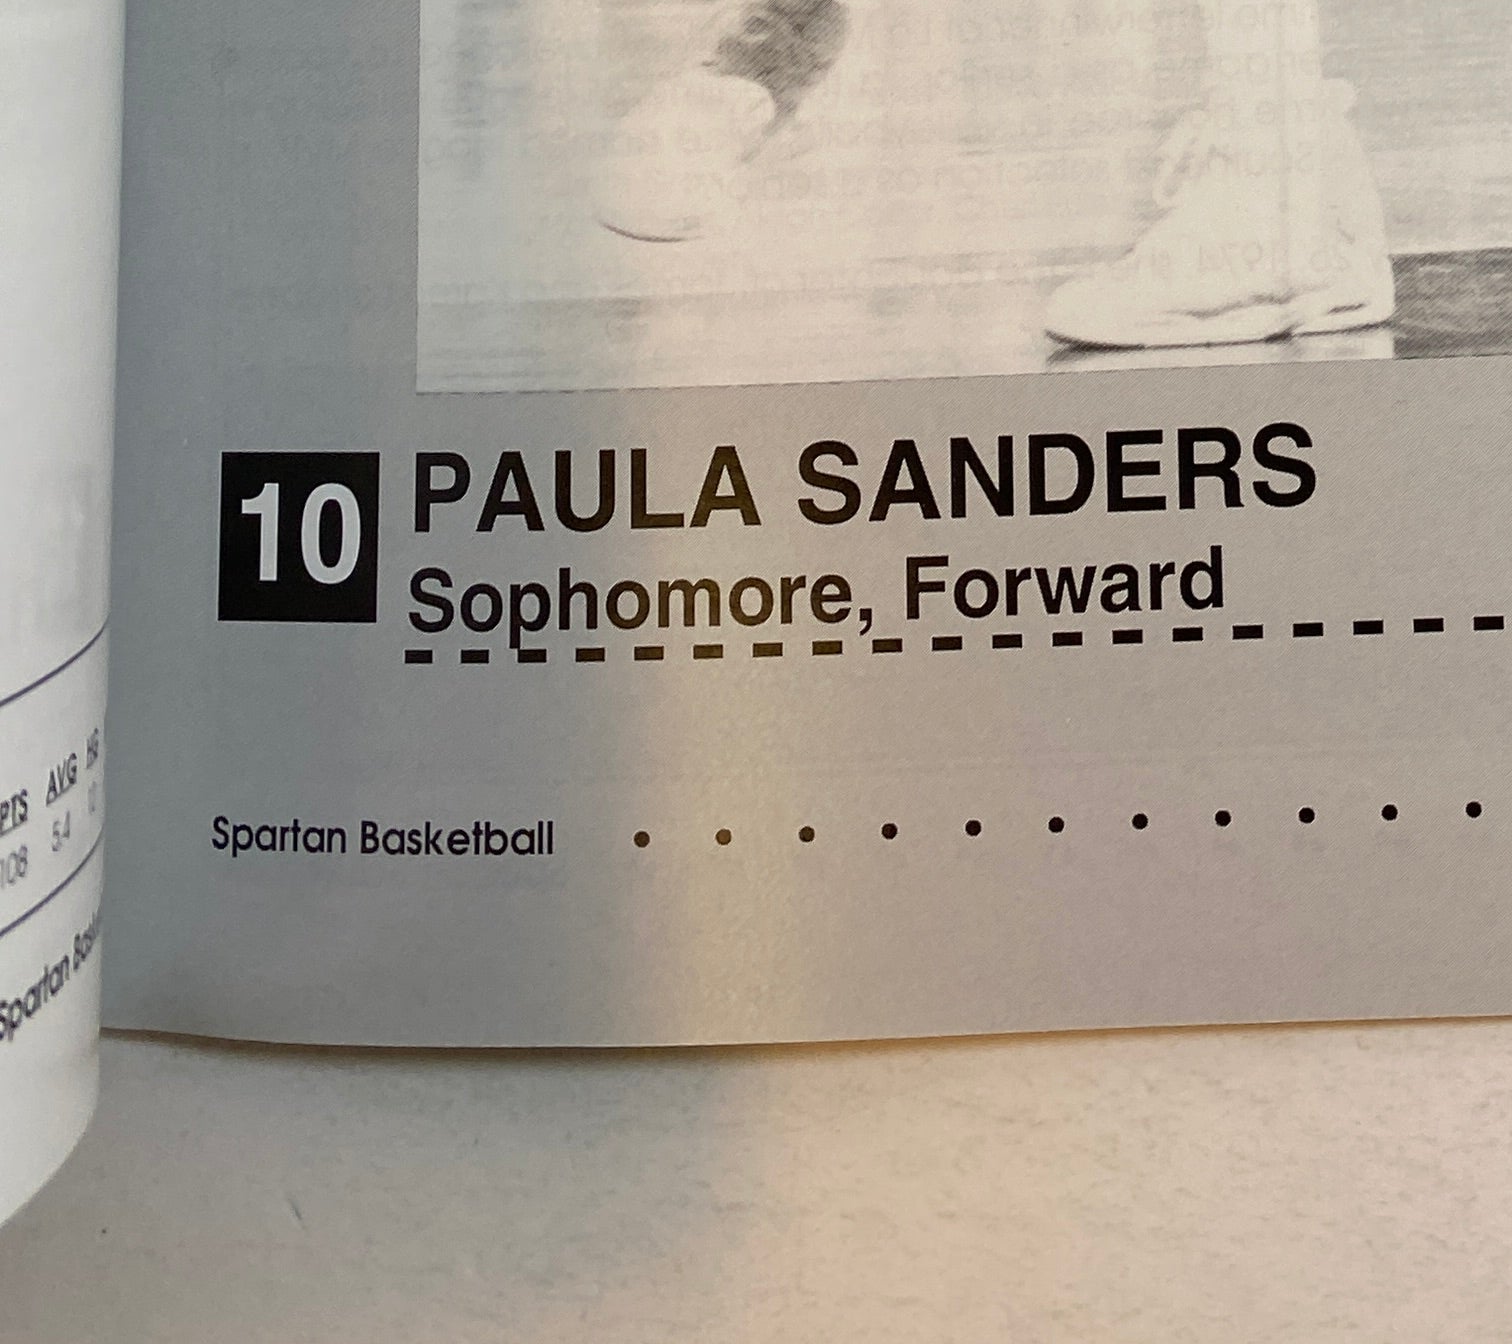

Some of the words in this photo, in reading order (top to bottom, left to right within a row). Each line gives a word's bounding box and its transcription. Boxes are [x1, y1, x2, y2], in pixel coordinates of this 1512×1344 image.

[414, 445, 762, 534] PAULA
[797, 422, 1317, 526] SANDERS
[240, 482, 361, 586] 10
[408, 567, 873, 650] Sophomore,
[906, 544, 1224, 621] Forward
[46, 752, 77, 807] AVG
[210, 815, 348, 860] Spartan
[358, 819, 555, 856] Basketball
